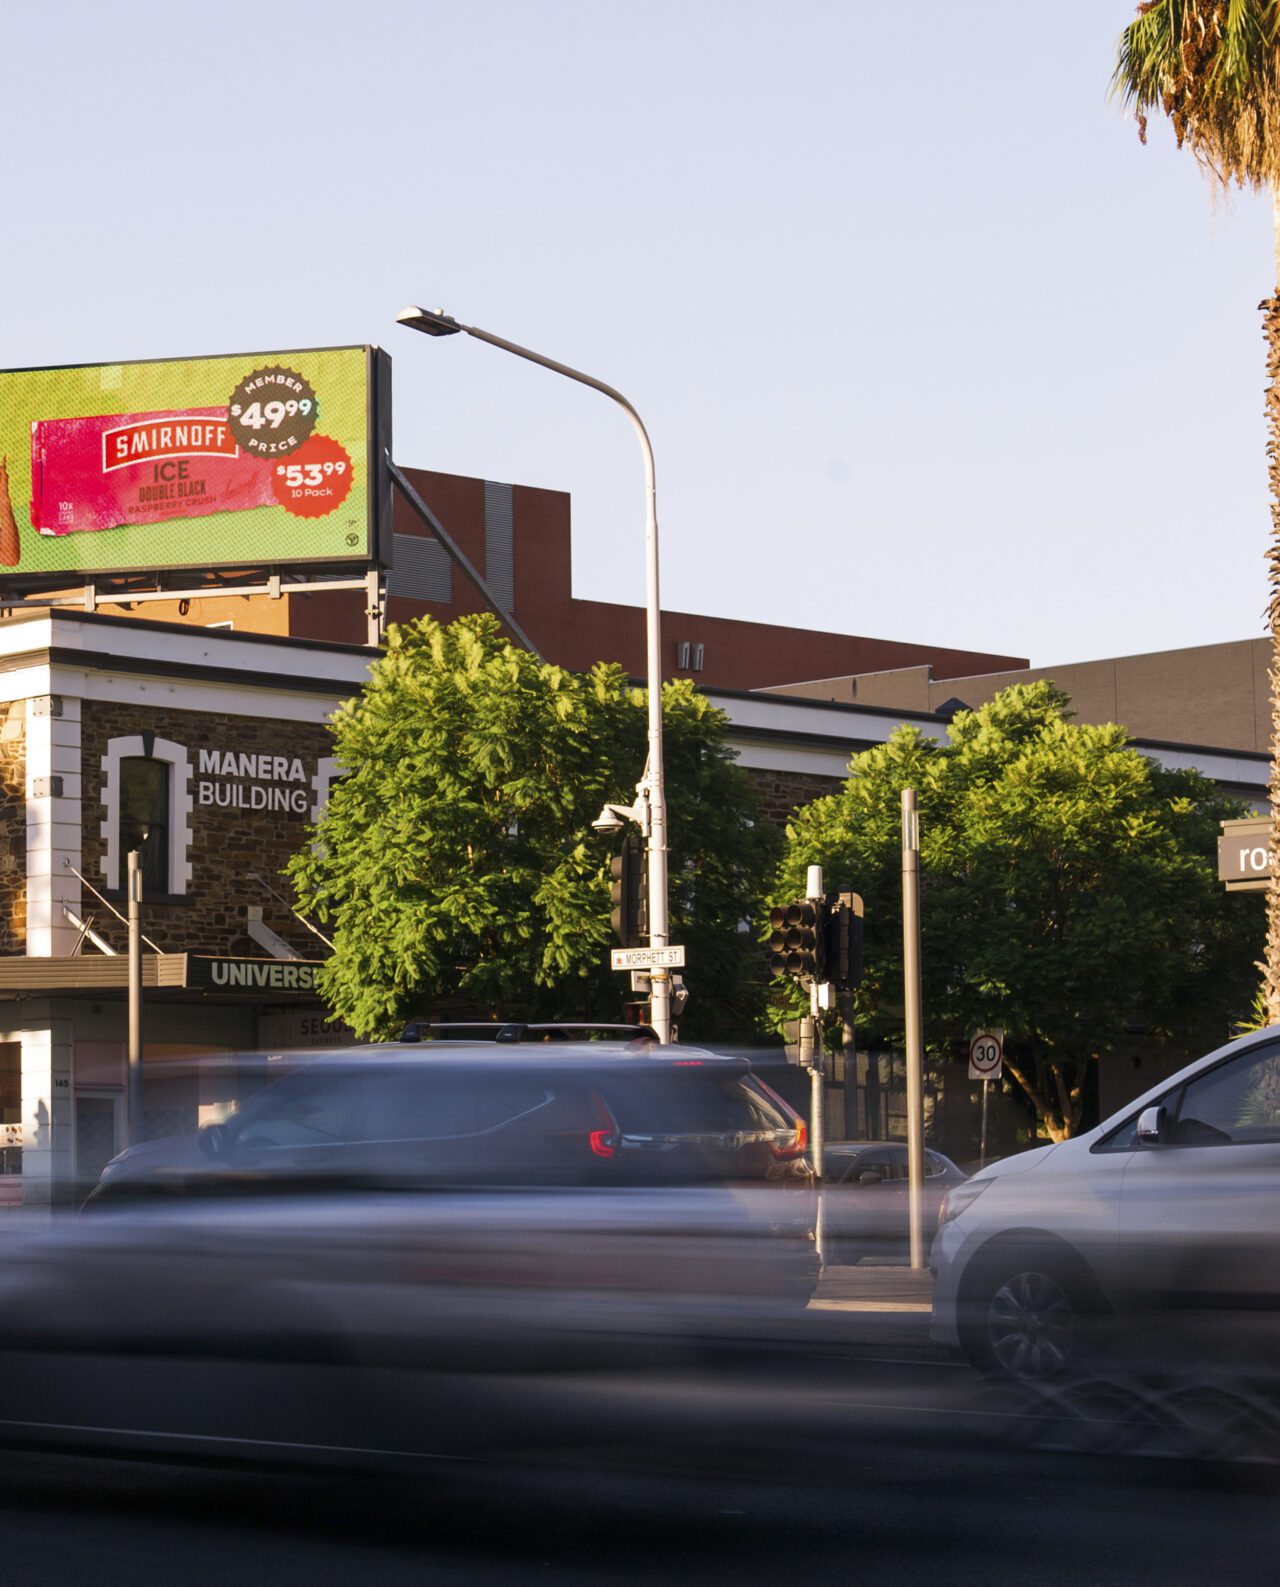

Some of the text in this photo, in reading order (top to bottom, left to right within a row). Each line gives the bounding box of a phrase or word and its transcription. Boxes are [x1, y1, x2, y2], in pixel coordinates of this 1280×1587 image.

[244, 374, 303, 394] MEMBER
[116, 425, 226, 458] SMIRNOFF
[248, 435, 297, 452] PRICE
[153, 460, 189, 482] ICE
[139, 480, 206, 503] DOUBLE BLACK
[291, 488, 332, 498] 10 Pack
[128, 496, 217, 514] RASPBERRY CRUSH
[199, 749, 307, 783] MANERA
[199, 781, 308, 813] BUILDING
[1239, 847, 1273, 872] ro
[626, 951, 677, 964] MORPHETT ST
[976, 1045, 996, 1062] 30
[55, 1079, 69, 1088] 165
